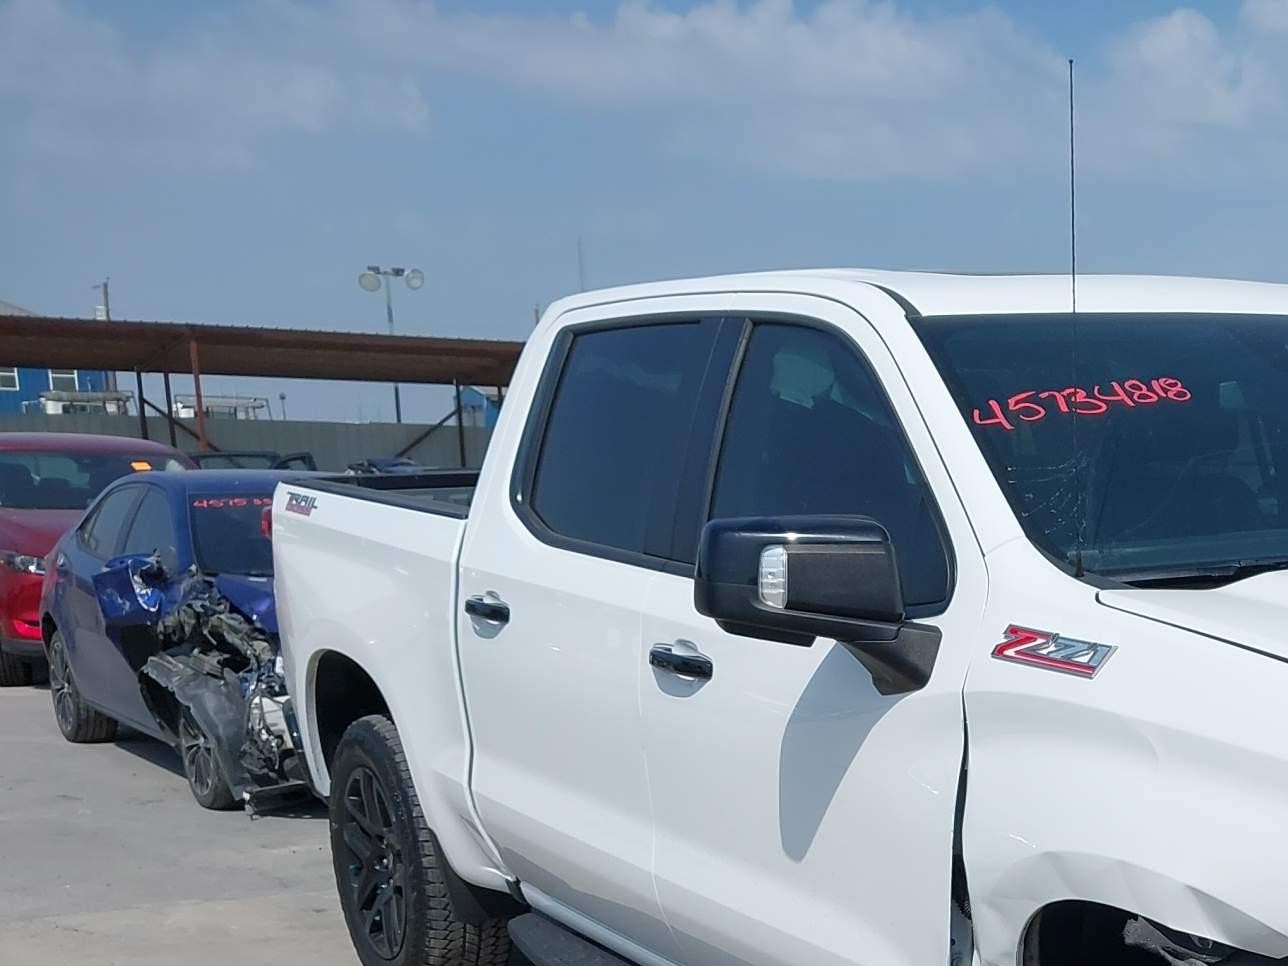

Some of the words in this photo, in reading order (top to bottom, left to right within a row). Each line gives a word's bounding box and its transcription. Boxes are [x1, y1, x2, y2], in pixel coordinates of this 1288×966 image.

[973, 377, 1192, 431] 45734818
[287, 491, 318, 509] TRAIL
[990, 623, 1116, 680] Z71
